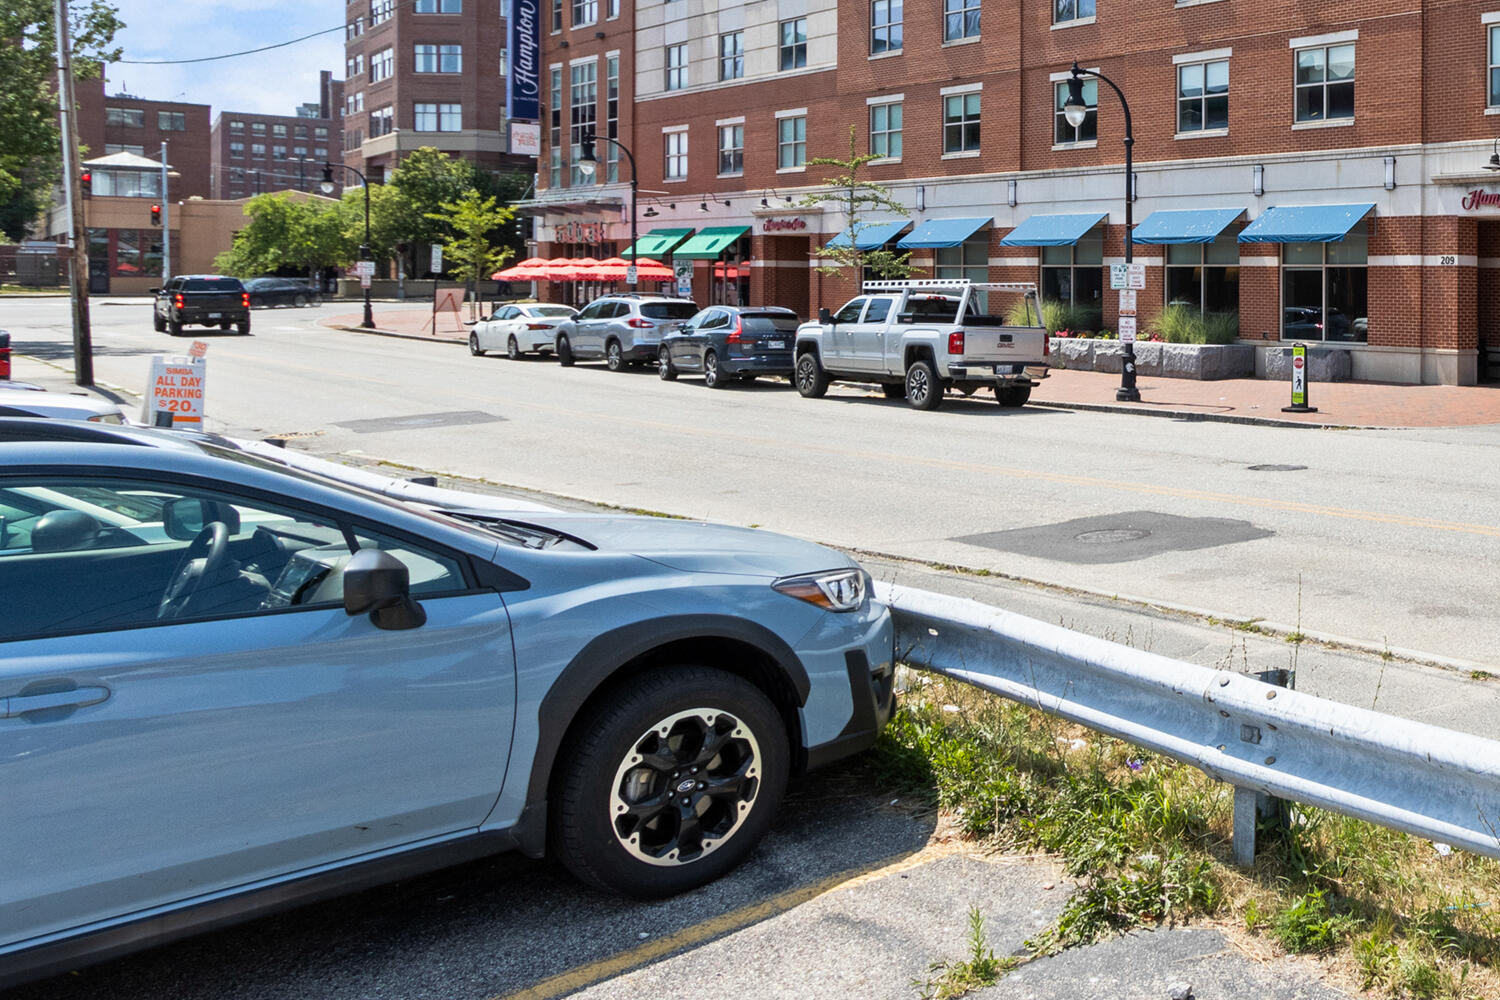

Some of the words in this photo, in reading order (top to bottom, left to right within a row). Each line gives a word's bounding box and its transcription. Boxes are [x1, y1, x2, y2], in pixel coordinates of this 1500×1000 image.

[513, 0, 538, 95] Hampton
[1440, 256, 1455, 265] 209
[156, 375, 176, 386] ALL
[180, 376, 202, 387] DAY
[154, 387, 202, 398] PARKING
[159, 399, 197, 412] $20.
